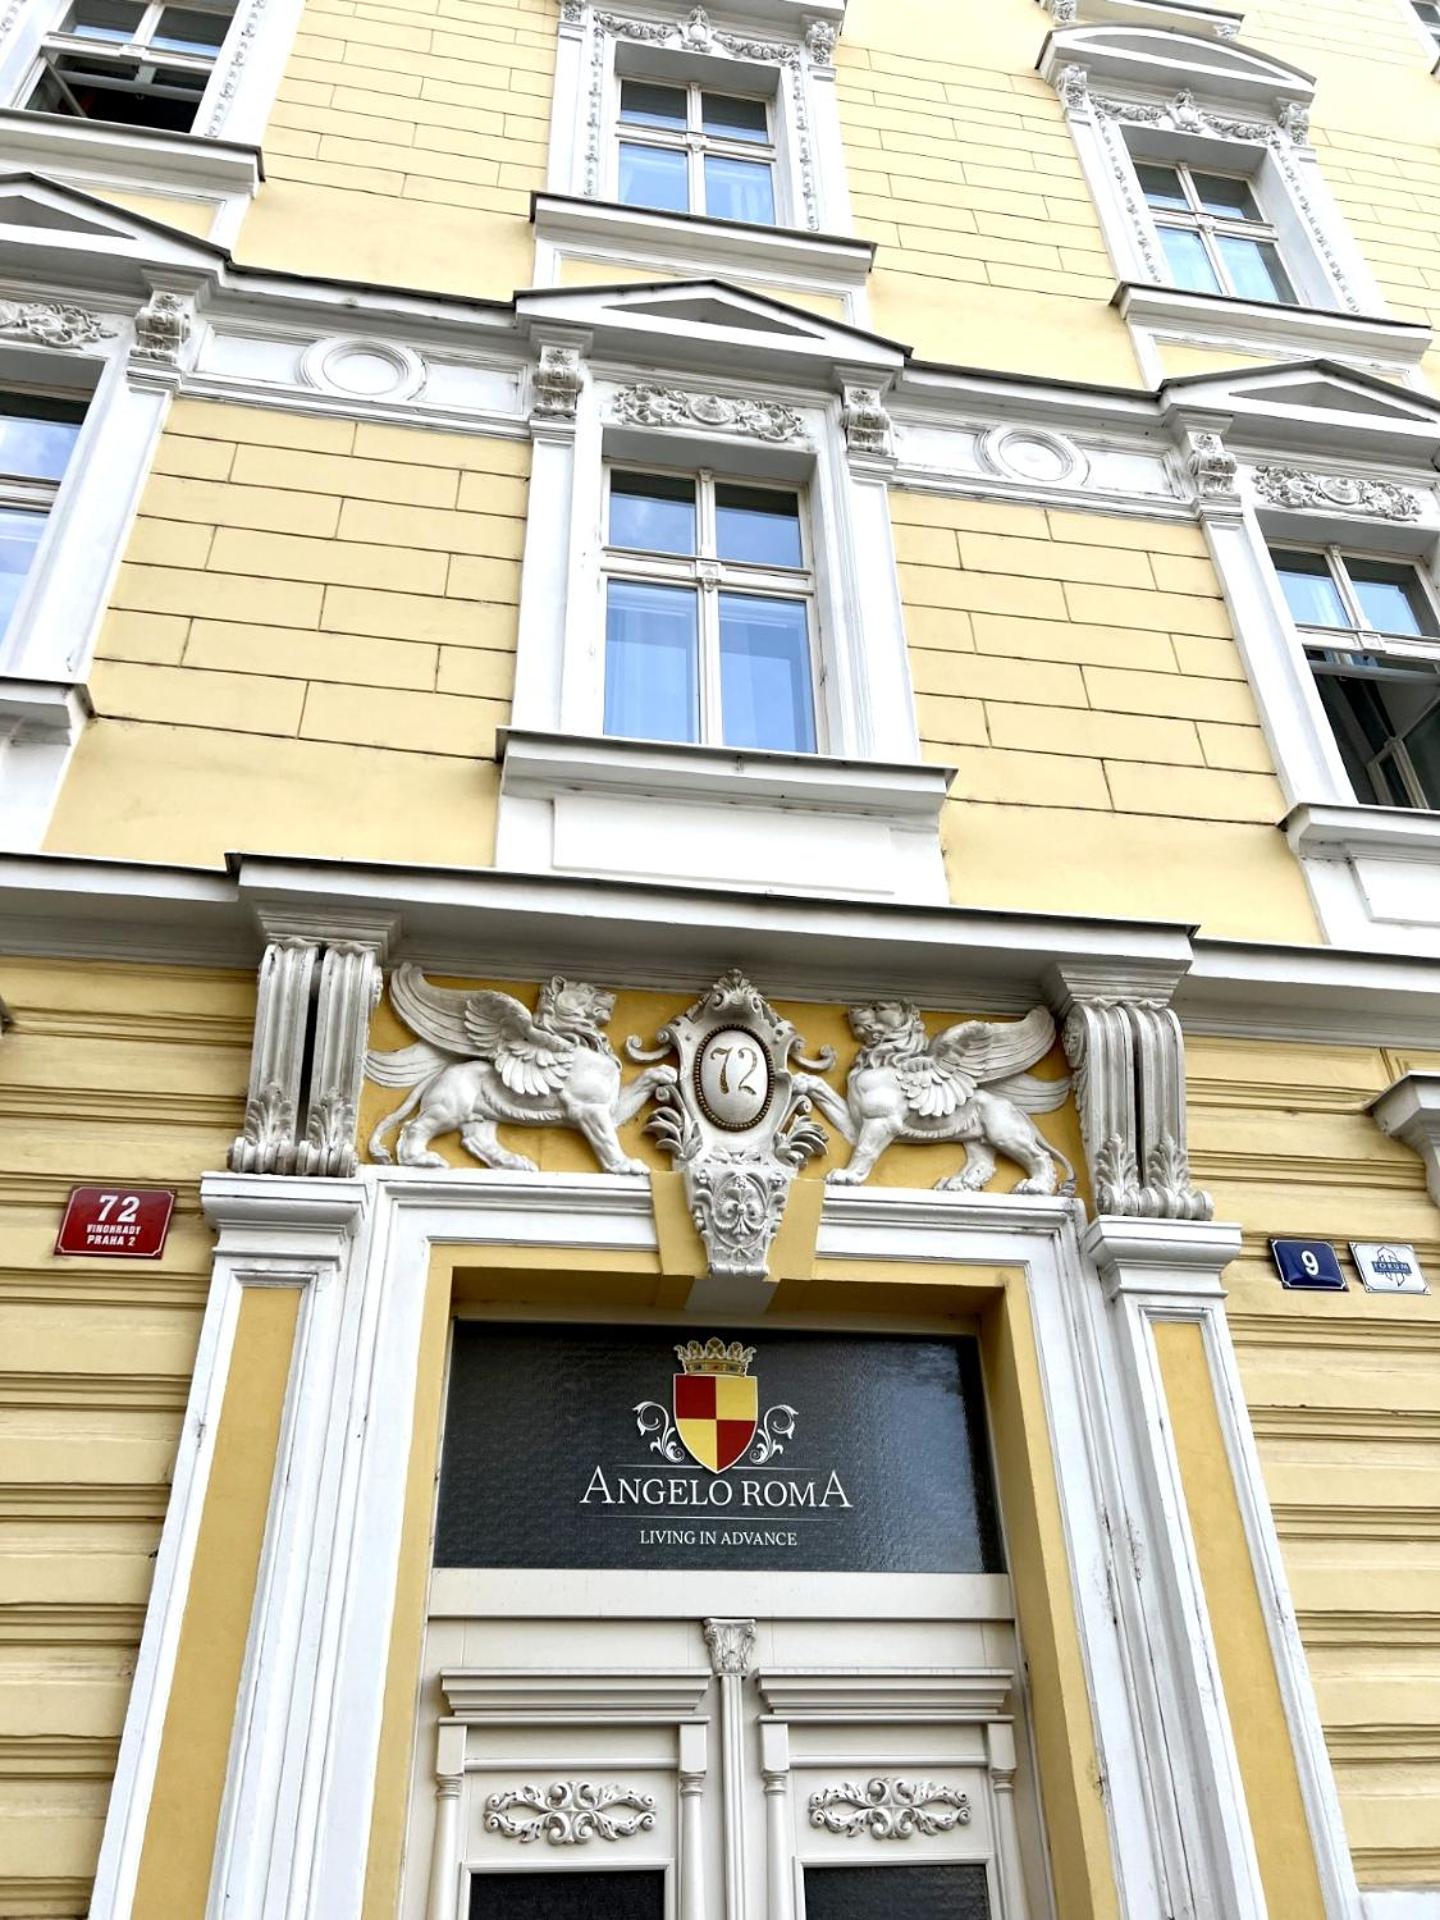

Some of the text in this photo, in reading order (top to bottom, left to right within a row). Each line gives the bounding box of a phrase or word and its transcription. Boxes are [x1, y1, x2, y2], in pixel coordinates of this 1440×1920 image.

[710, 1046, 757, 1096] 72
[98, 1194, 140, 1223] 72
[86, 1224, 141, 1235] VINOHRADY
[87, 1234, 136, 1246] PRAHA 2
[1301, 1250, 1320, 1276] 9
[579, 1465, 853, 1508] ANGELO ROMA
[639, 1530, 797, 1546] LIVING IN ADVANCE
